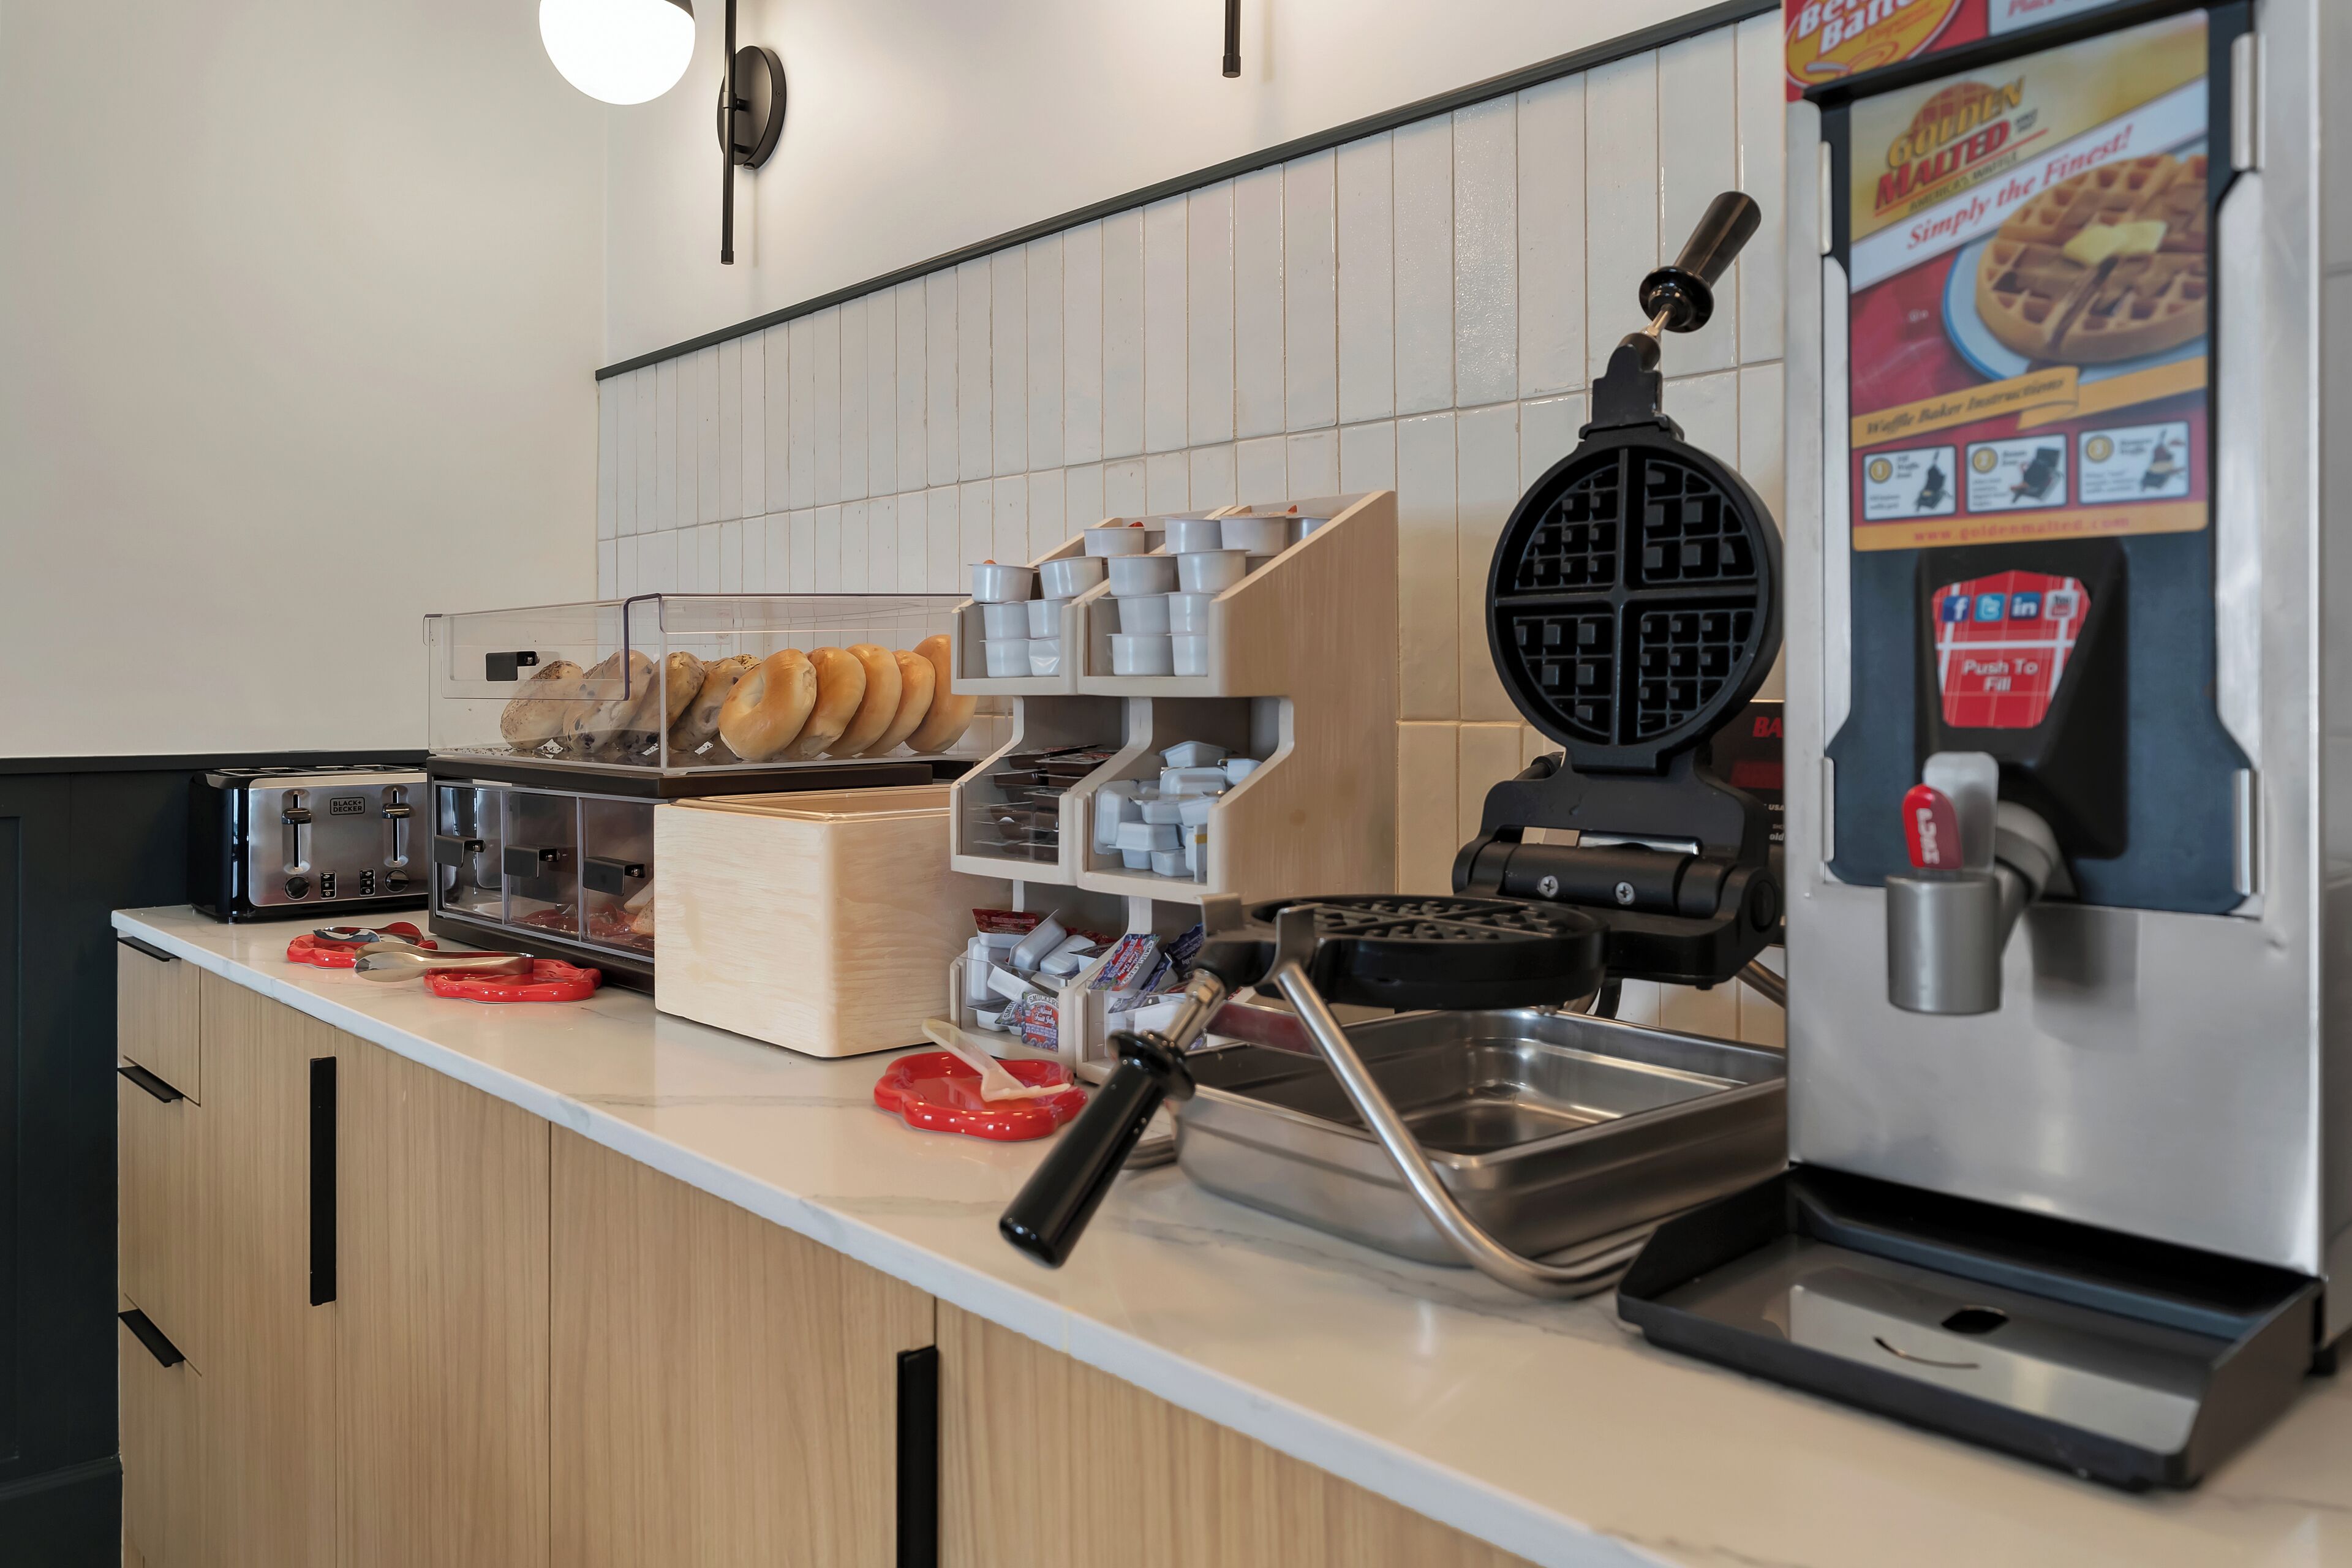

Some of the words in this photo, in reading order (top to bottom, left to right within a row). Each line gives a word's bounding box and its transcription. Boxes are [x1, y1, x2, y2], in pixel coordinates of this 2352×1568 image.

[1887, 75, 2025, 169] GOLDEN
[1875, 119, 2011, 210] MALTED
[1907, 195, 1991, 249] Simply
[1997, 178, 2037, 208] the
[2043, 124, 2133, 186] Finest!
[1962, 658, 2009, 676] Push
[2013, 658, 2038, 676] To
[1983, 676, 2011, 693] Fill
[1045, 1016, 1056, 1026] Jelly
